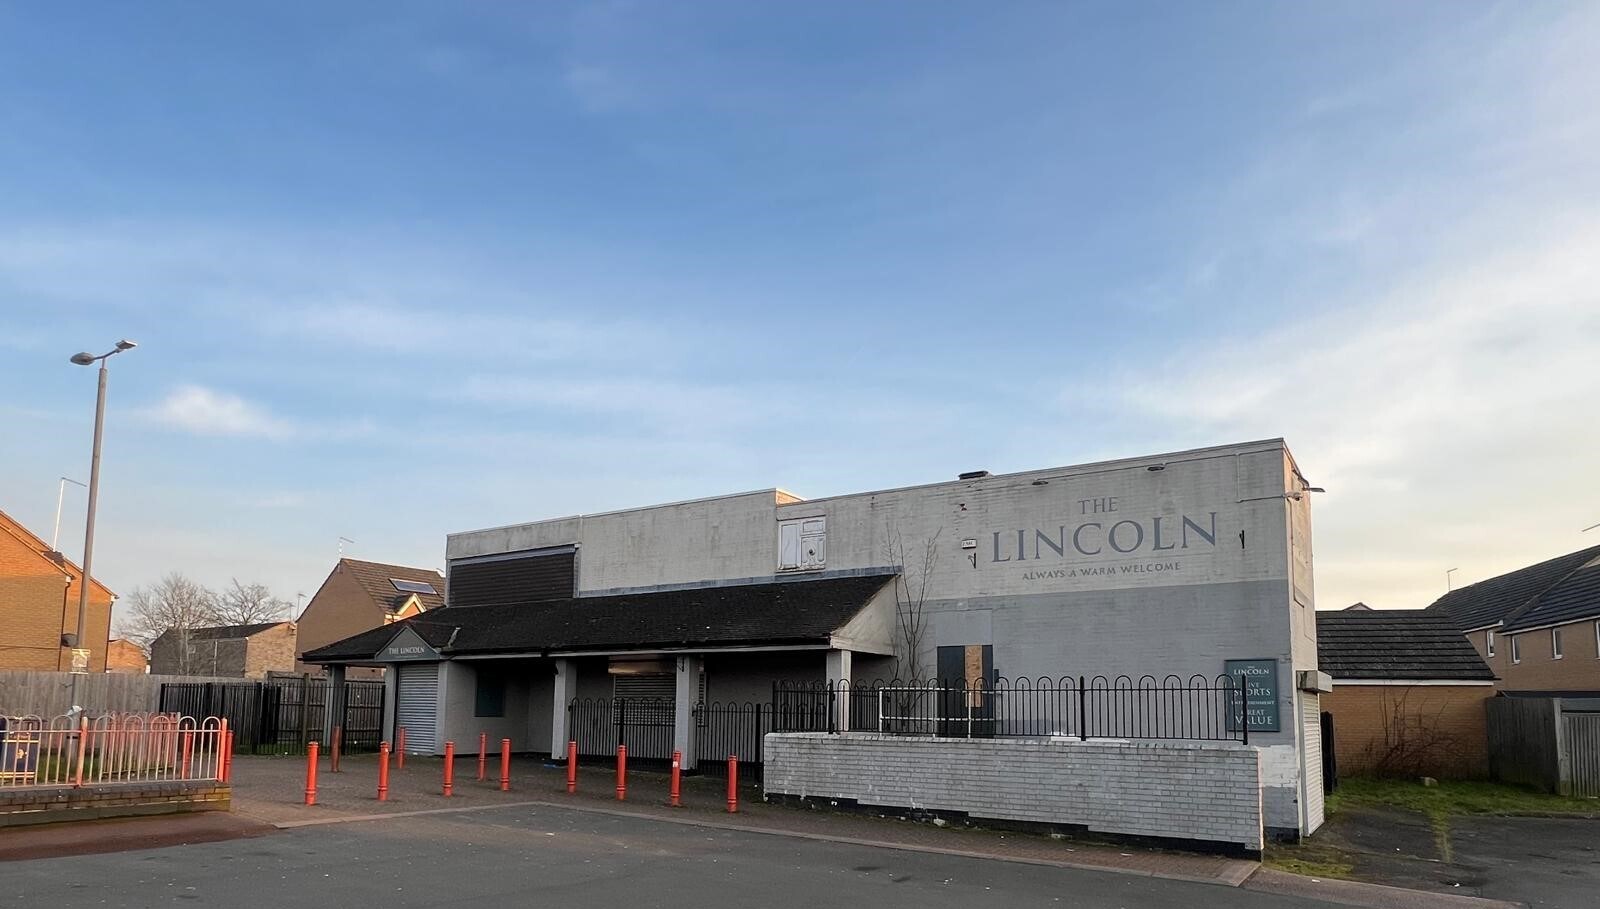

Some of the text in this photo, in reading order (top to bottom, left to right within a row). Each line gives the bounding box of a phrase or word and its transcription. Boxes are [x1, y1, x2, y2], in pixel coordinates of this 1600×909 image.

[1077, 496, 1119, 514] THE
[992, 511, 1217, 562] LINCOLN
[1022, 561, 1182, 581] ALWAYS A WARM WELCOME
